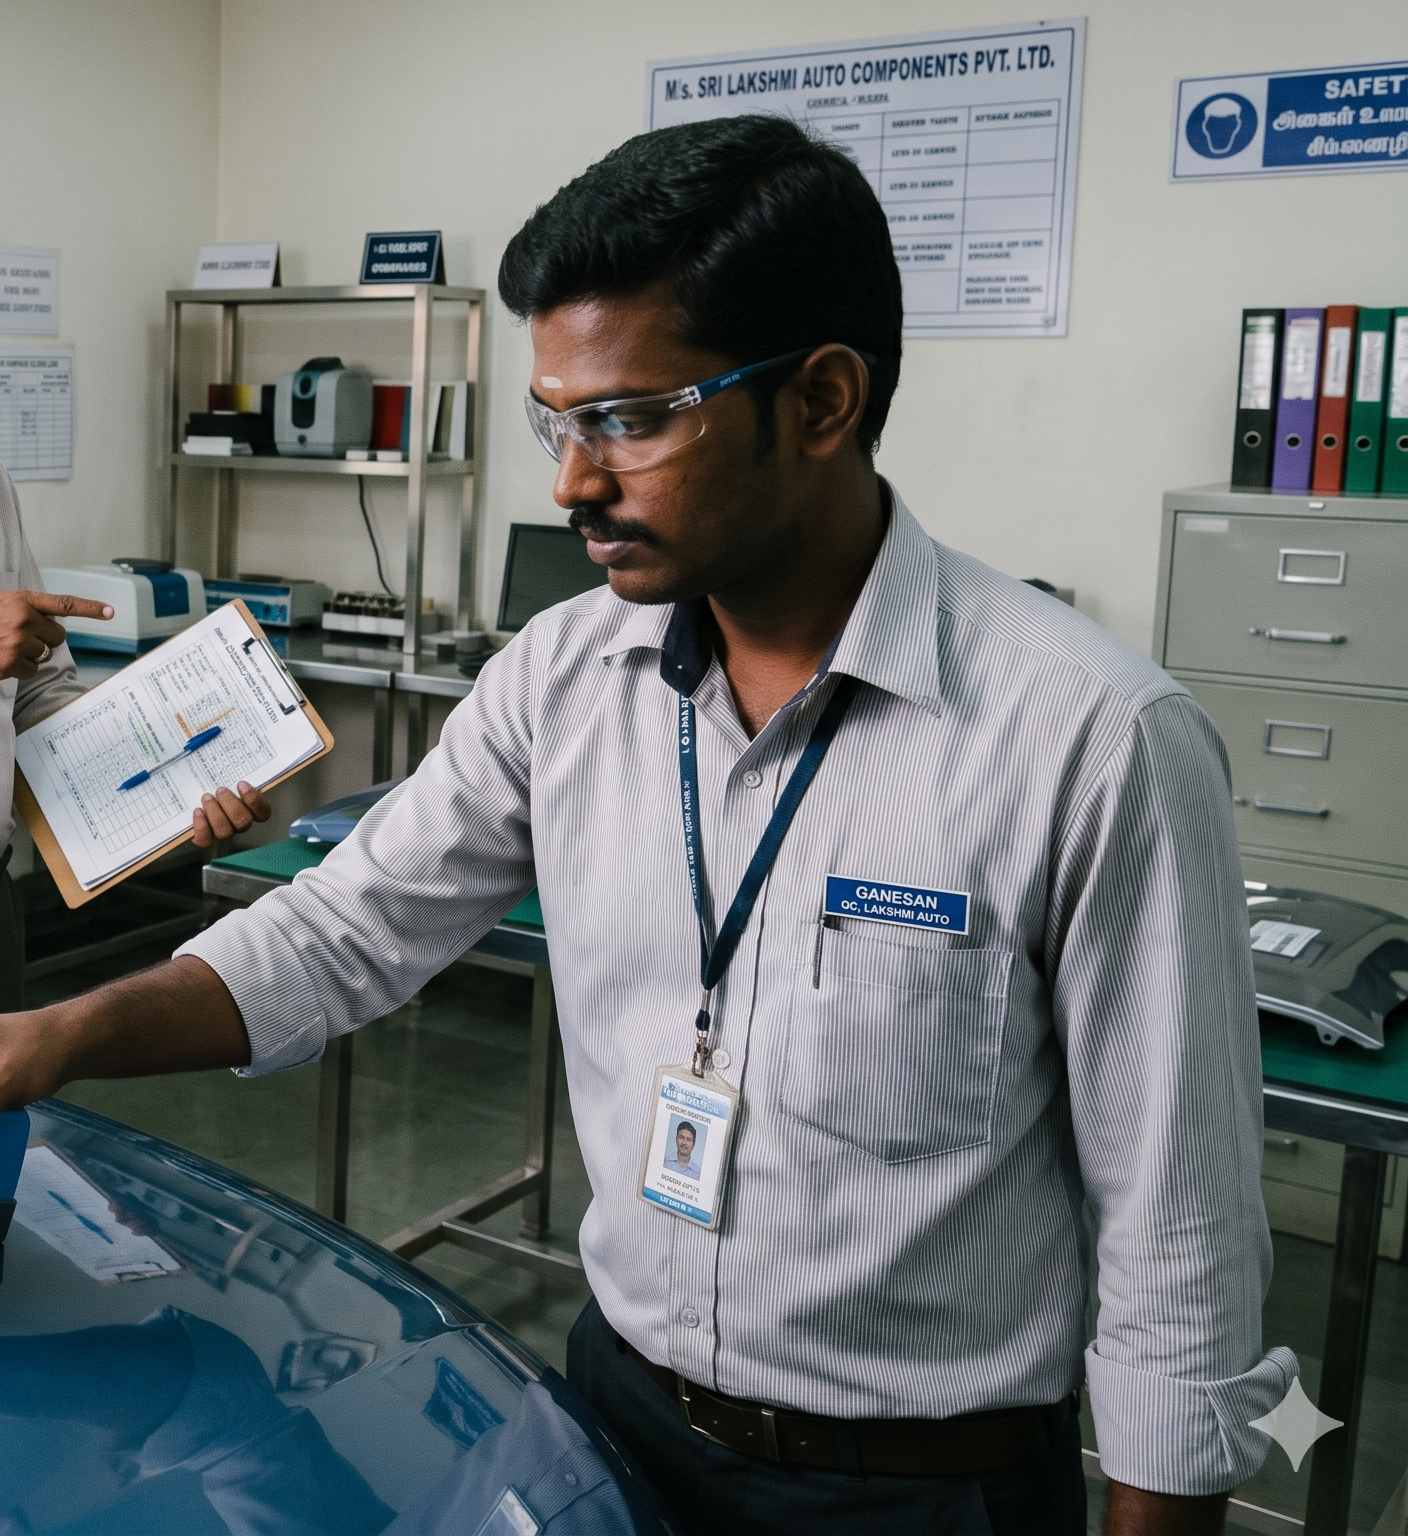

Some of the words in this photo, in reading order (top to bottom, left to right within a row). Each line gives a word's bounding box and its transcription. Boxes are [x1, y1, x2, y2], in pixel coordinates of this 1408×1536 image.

[697, 75, 723, 98] SRI
[727, 67, 797, 96] LAKSHMI
[802, 63, 846, 90] AUTO
[851, 52, 969, 85] COMPONENTS
[974, 48, 1011, 75] PVT.
[1017, 44, 1056, 71] LTD.
[1324, 74, 1408, 99] SAFET
[855, 886, 938, 910] GANESAN
[864, 903, 915, 920] LAKSHMI
[917, 913, 950, 925] AUTO
